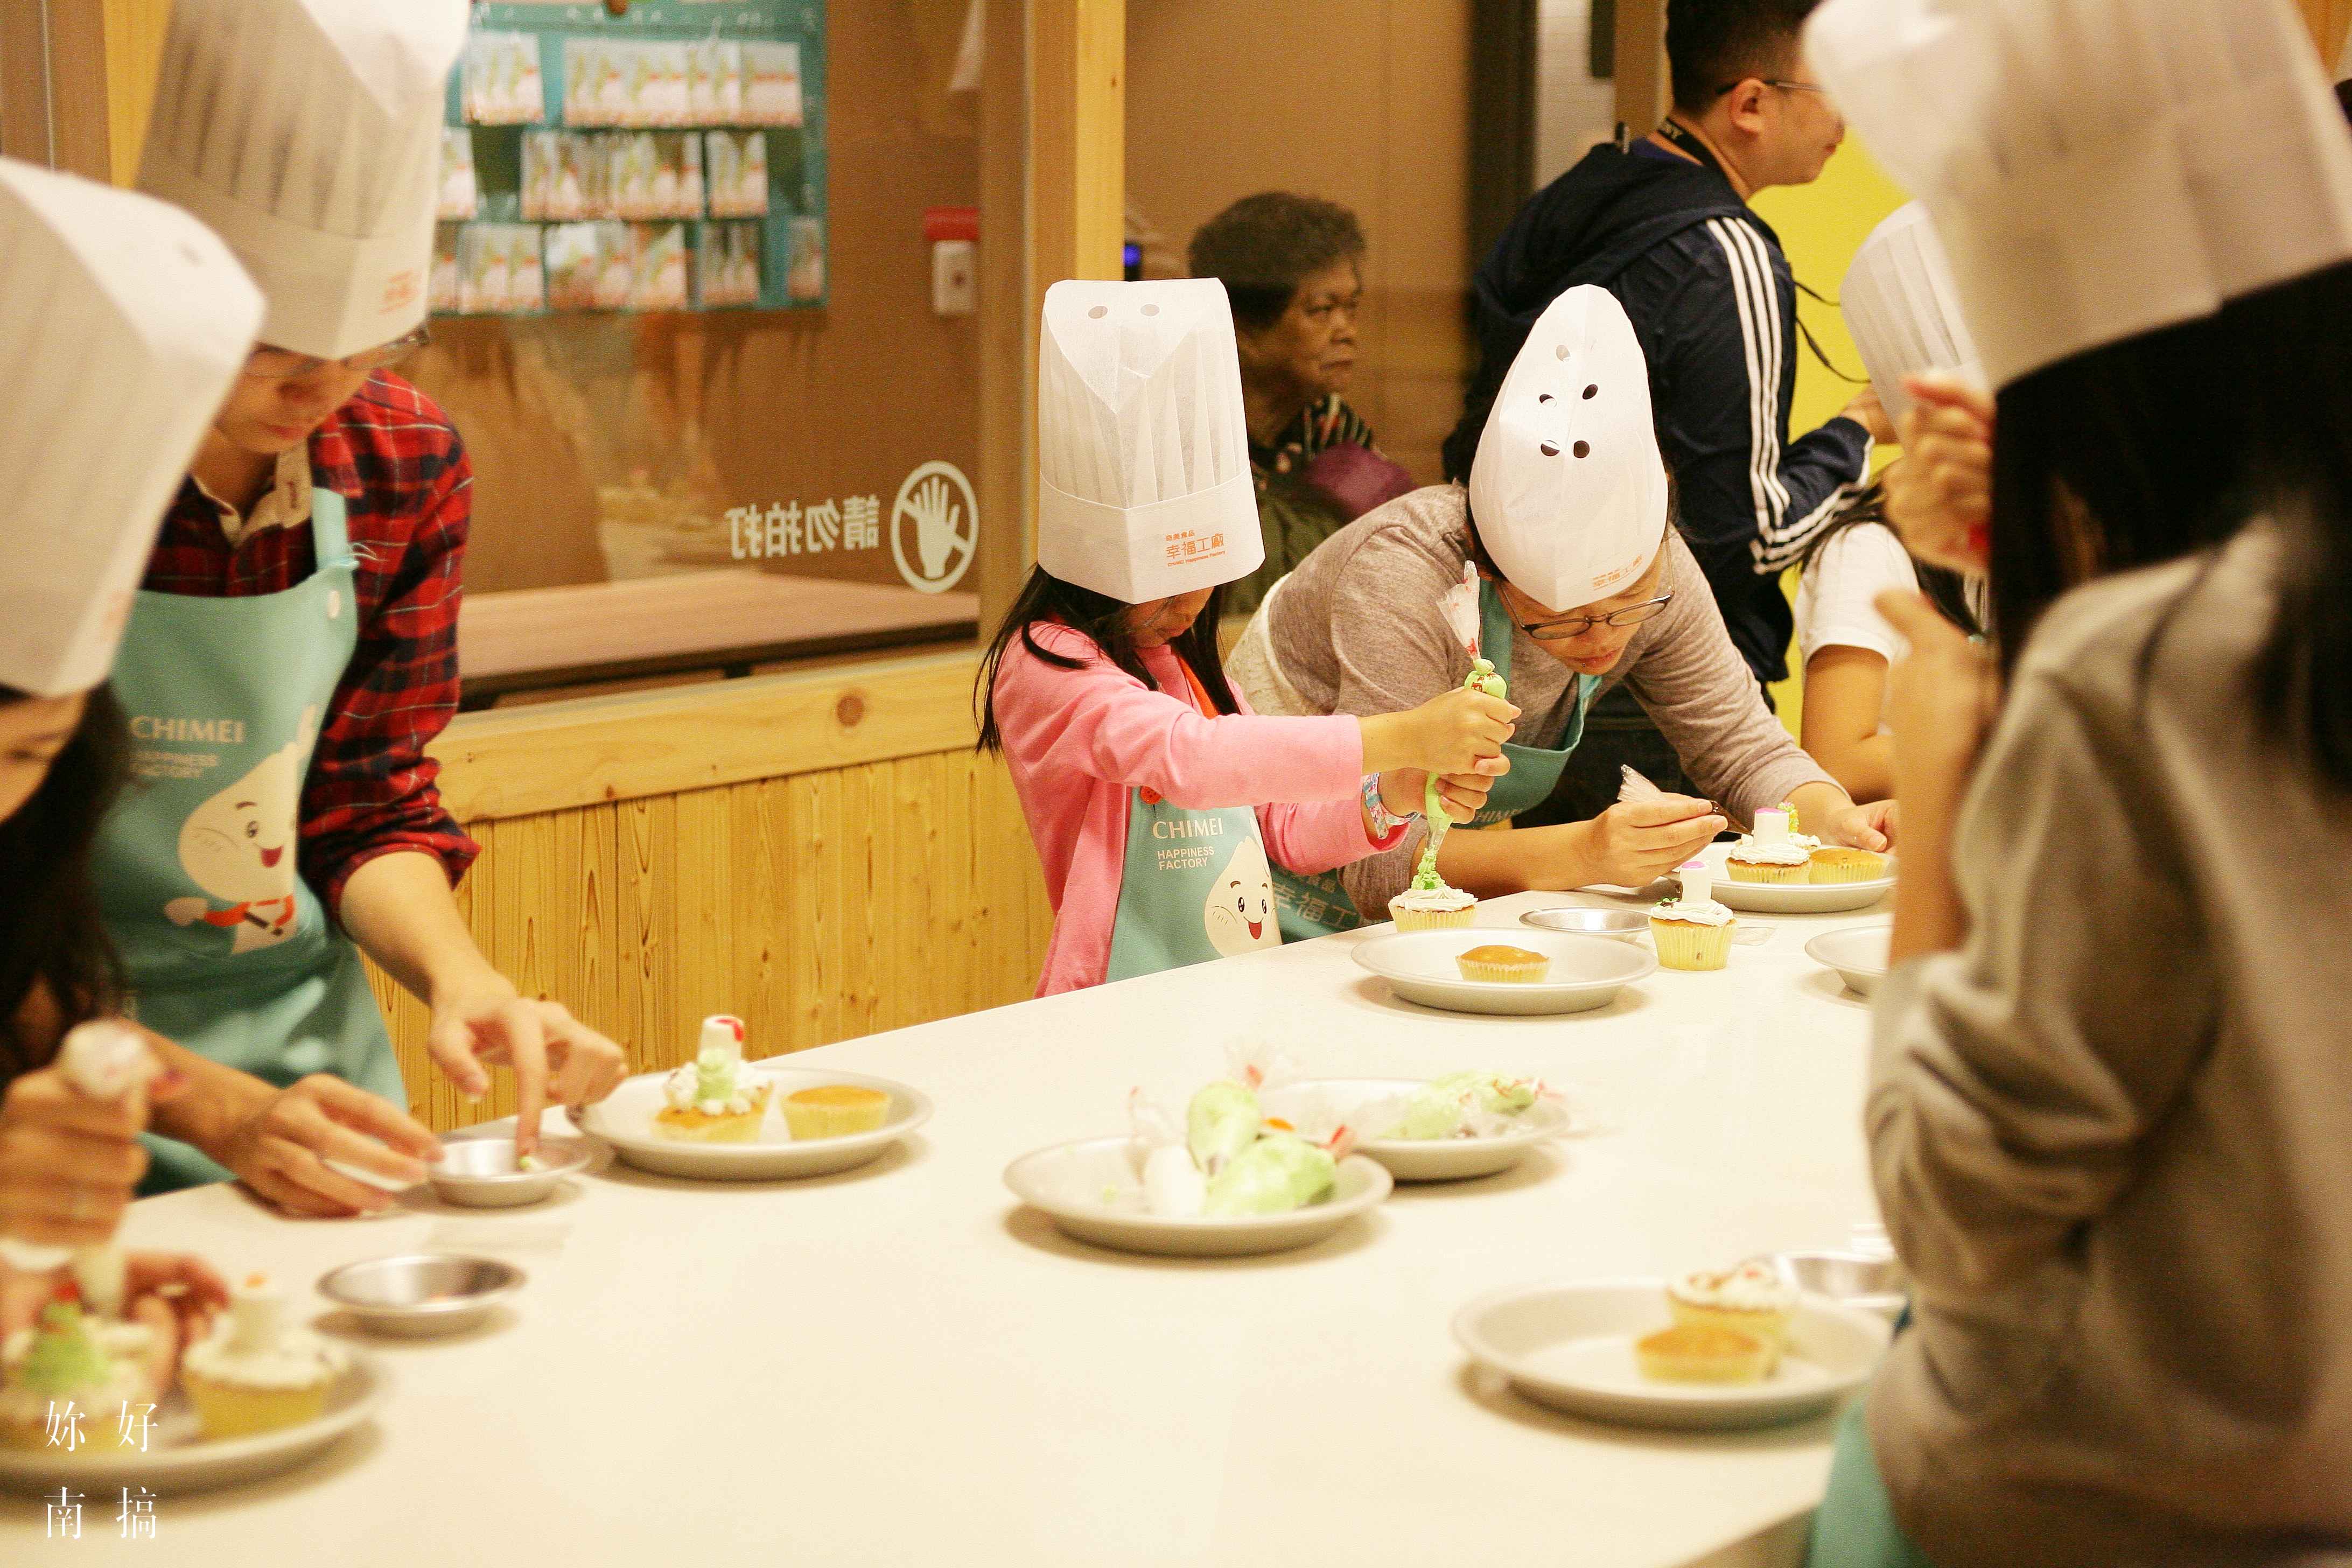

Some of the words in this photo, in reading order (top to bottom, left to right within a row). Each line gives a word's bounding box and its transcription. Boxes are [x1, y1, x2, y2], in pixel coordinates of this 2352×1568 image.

[1166, 534, 1224, 559] 幸福工廠
[129, 715, 245, 744] CHIMEI
[1153, 818, 1223, 839] CHIMEI
[1158, 846, 1215, 860] HAPPINESS
[1159, 857, 1208, 871] FACTORY
